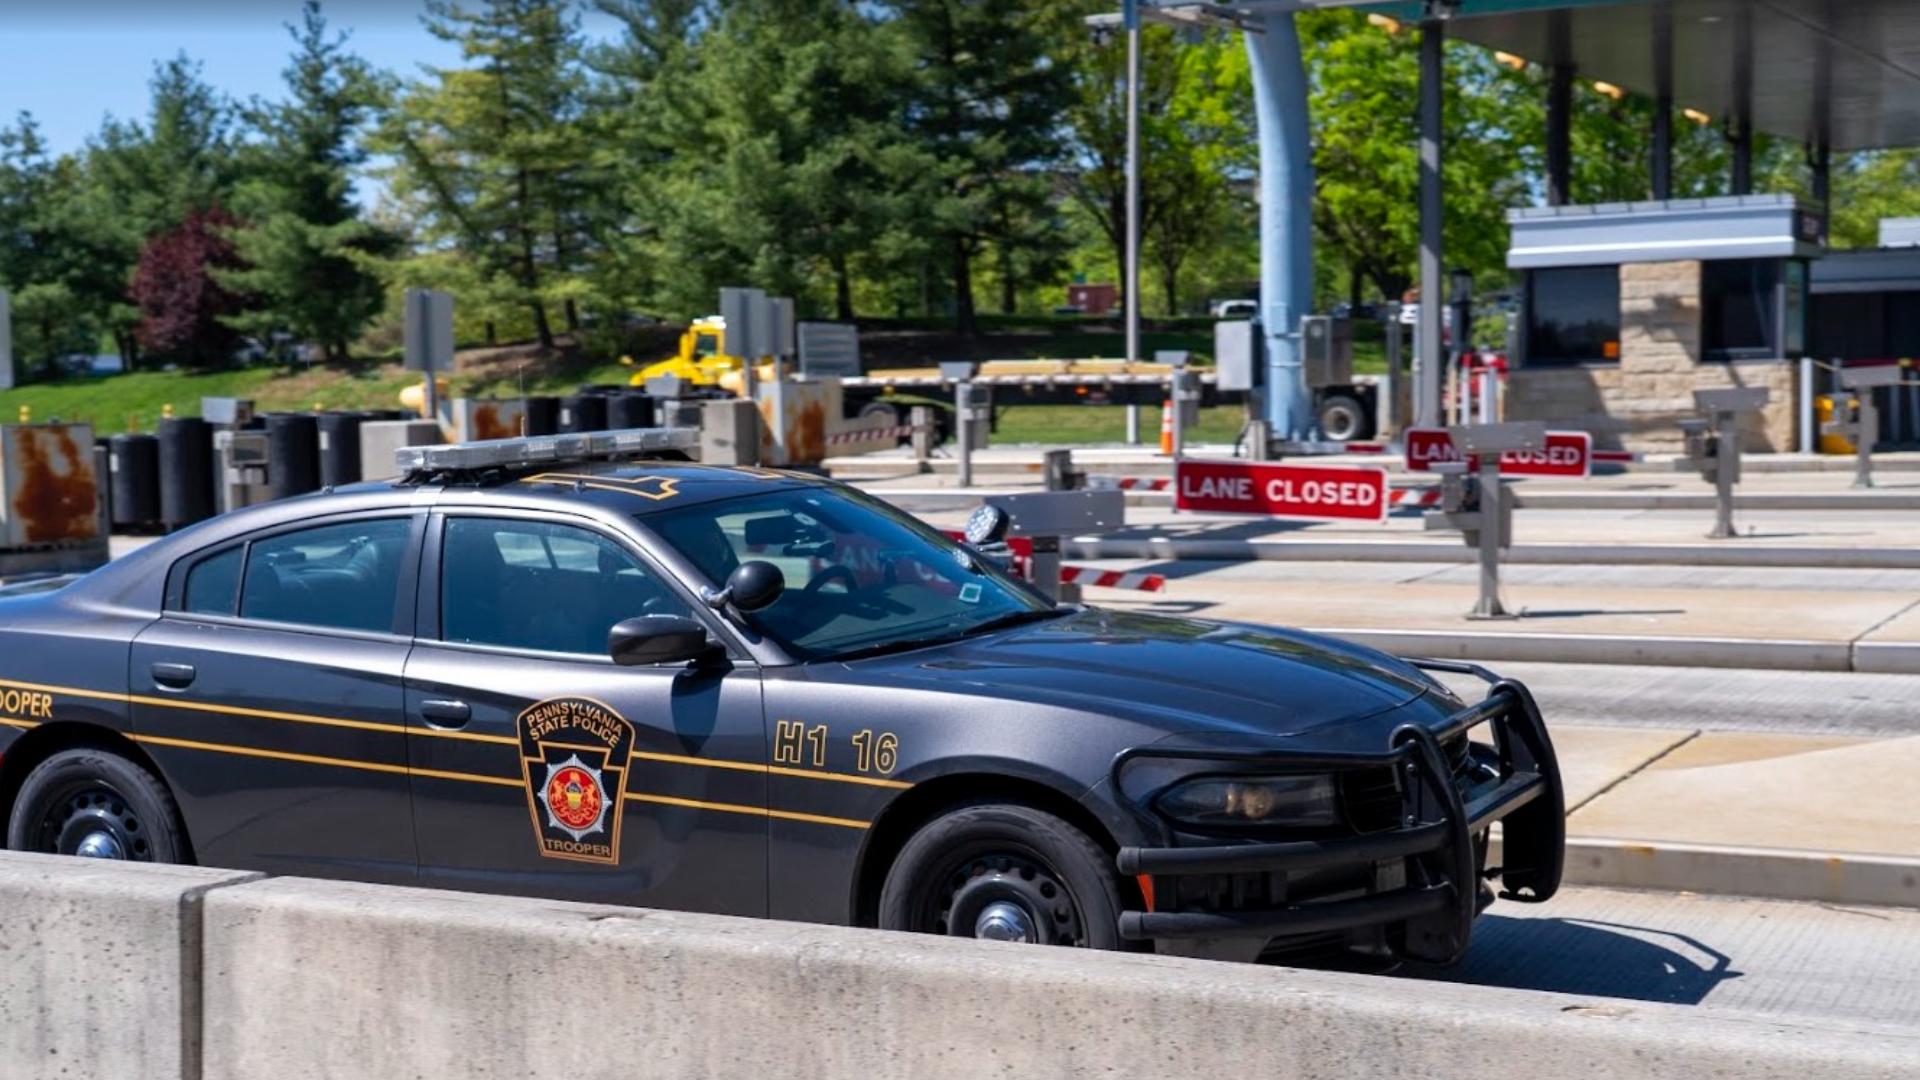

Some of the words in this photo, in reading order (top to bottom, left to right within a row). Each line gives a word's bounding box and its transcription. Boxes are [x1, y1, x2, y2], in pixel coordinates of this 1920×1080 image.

[1501, 446, 1580, 466] LOSED
[1182, 475, 1253, 500] LANE
[1266, 479, 1377, 507] CLOSED
[0, 689, 52, 718] OPER
[526, 702, 624, 737] PENNSYLVANIA
[529, 715, 570, 741] STATE
[573, 714, 620, 748] POLICE
[774, 720, 828, 767] H1
[852, 729, 898, 774] 16
[545, 838, 611, 856] TROOPER
